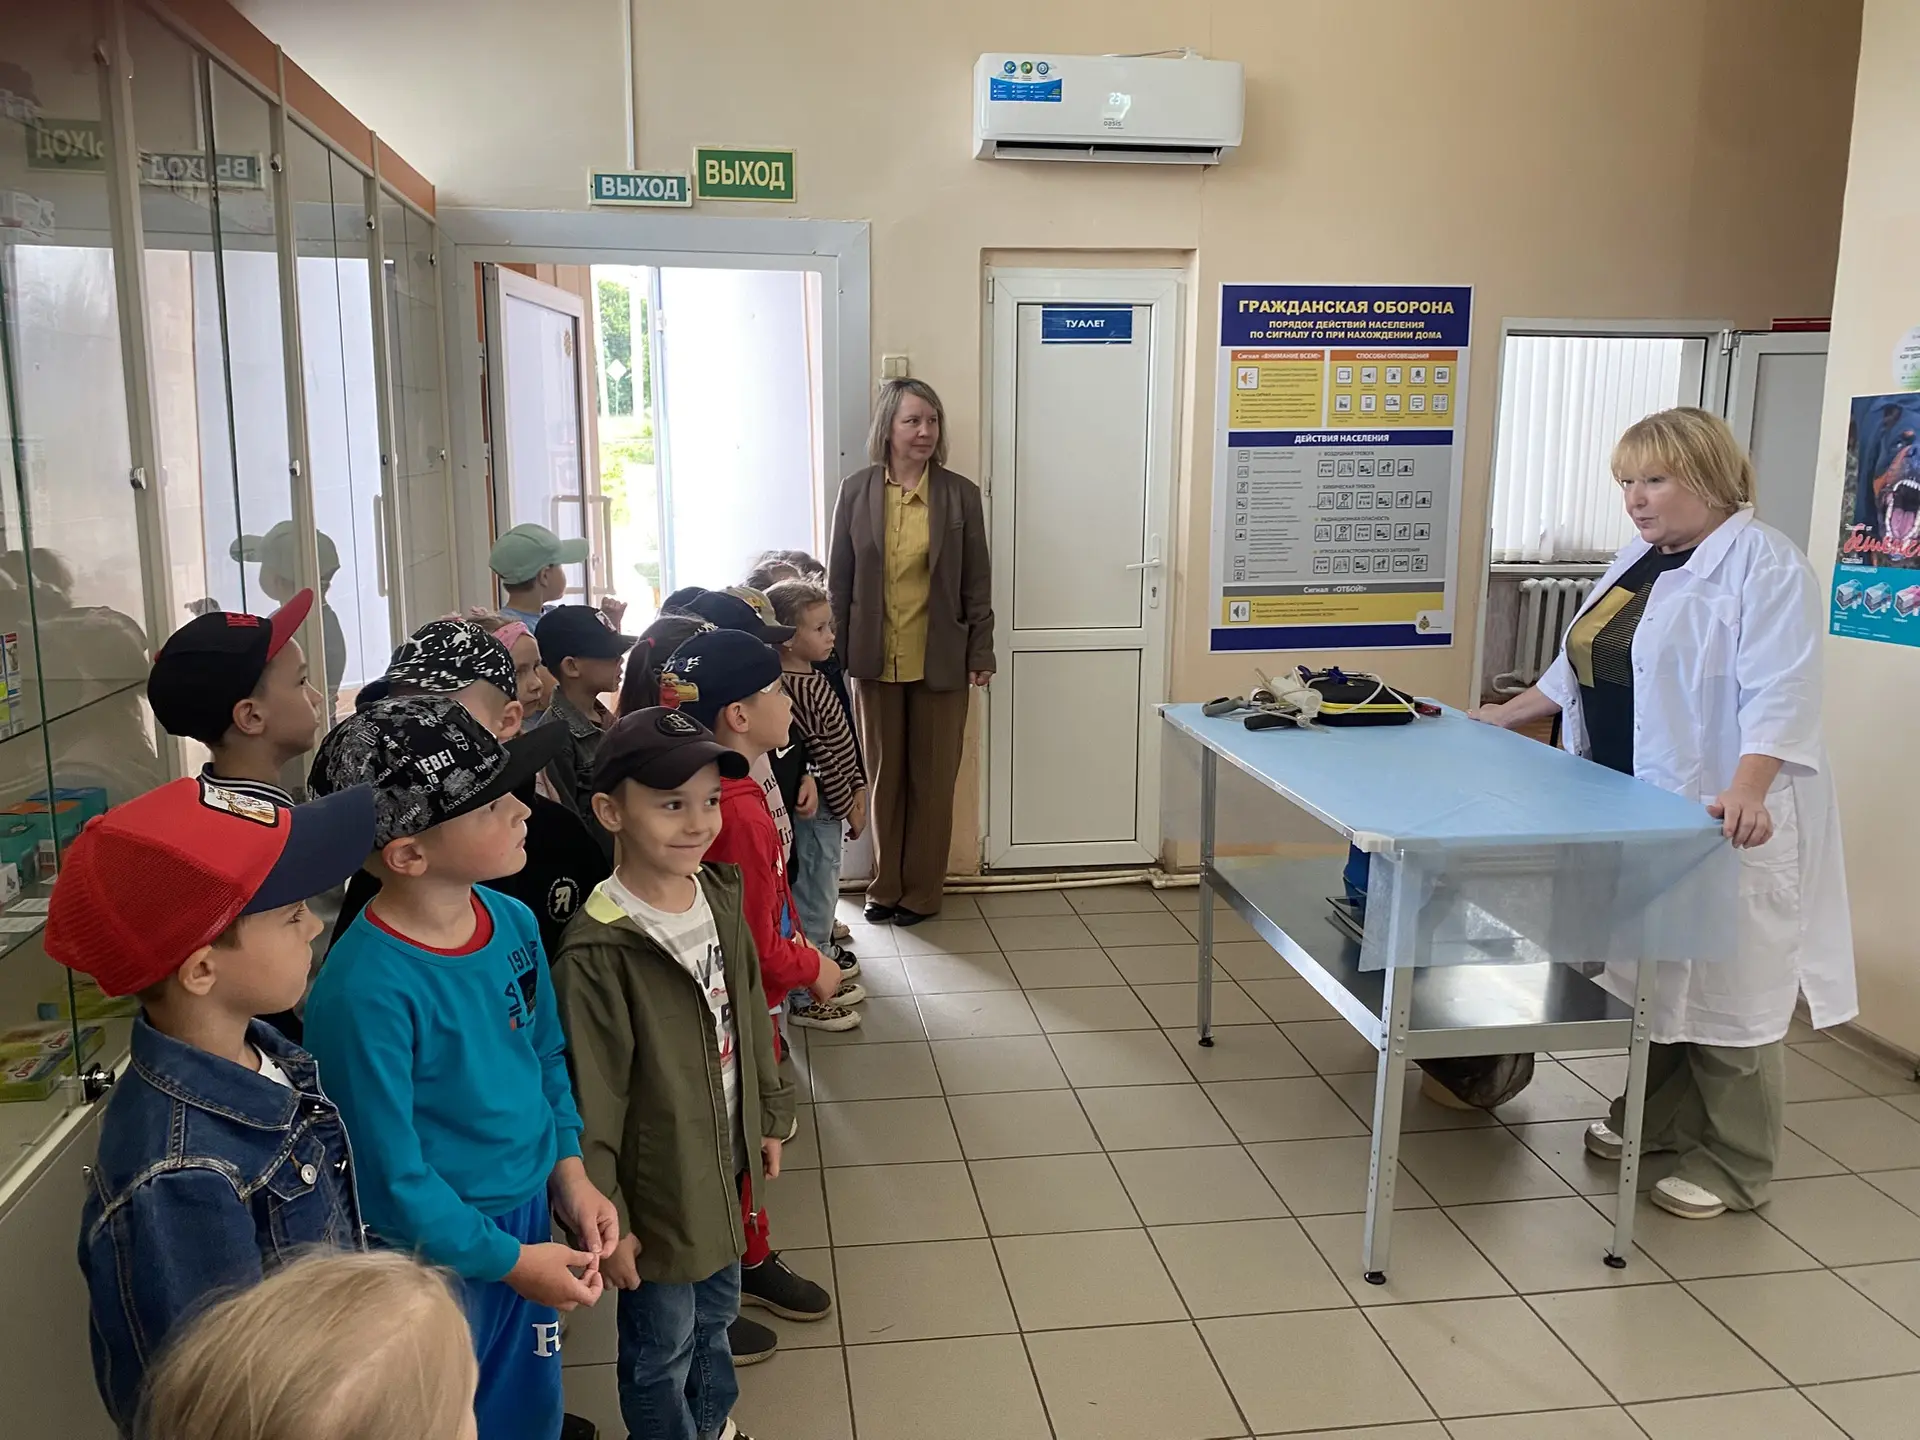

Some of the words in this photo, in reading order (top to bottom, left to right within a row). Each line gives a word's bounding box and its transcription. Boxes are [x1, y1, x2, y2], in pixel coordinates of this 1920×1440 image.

[705, 160, 785, 190] ВЫХОД
[601, 177, 679, 200] ВЫХОД
[1238, 300, 1368, 315] ГРАЖДАНСКАЯ
[1373, 301, 1454, 314] ОБОРОНА
[1065, 320, 1105, 328] ТУАЛЕТ
[1269, 321, 1314, 329] ПОРЯДОК
[1315, 319, 1366, 329] ДЕЙСТВИЙ
[1368, 321, 1425, 329] НАСЕЛЕНИЯ
[1347, 331, 1413, 340] НАХОЖДЕНИИ
[1415, 331, 1442, 340] ДОМА
[1294, 434, 1339, 444] ДЕЙСТВИЯ
[1340, 434, 1390, 442] НАСЕЛЕНИЯ
